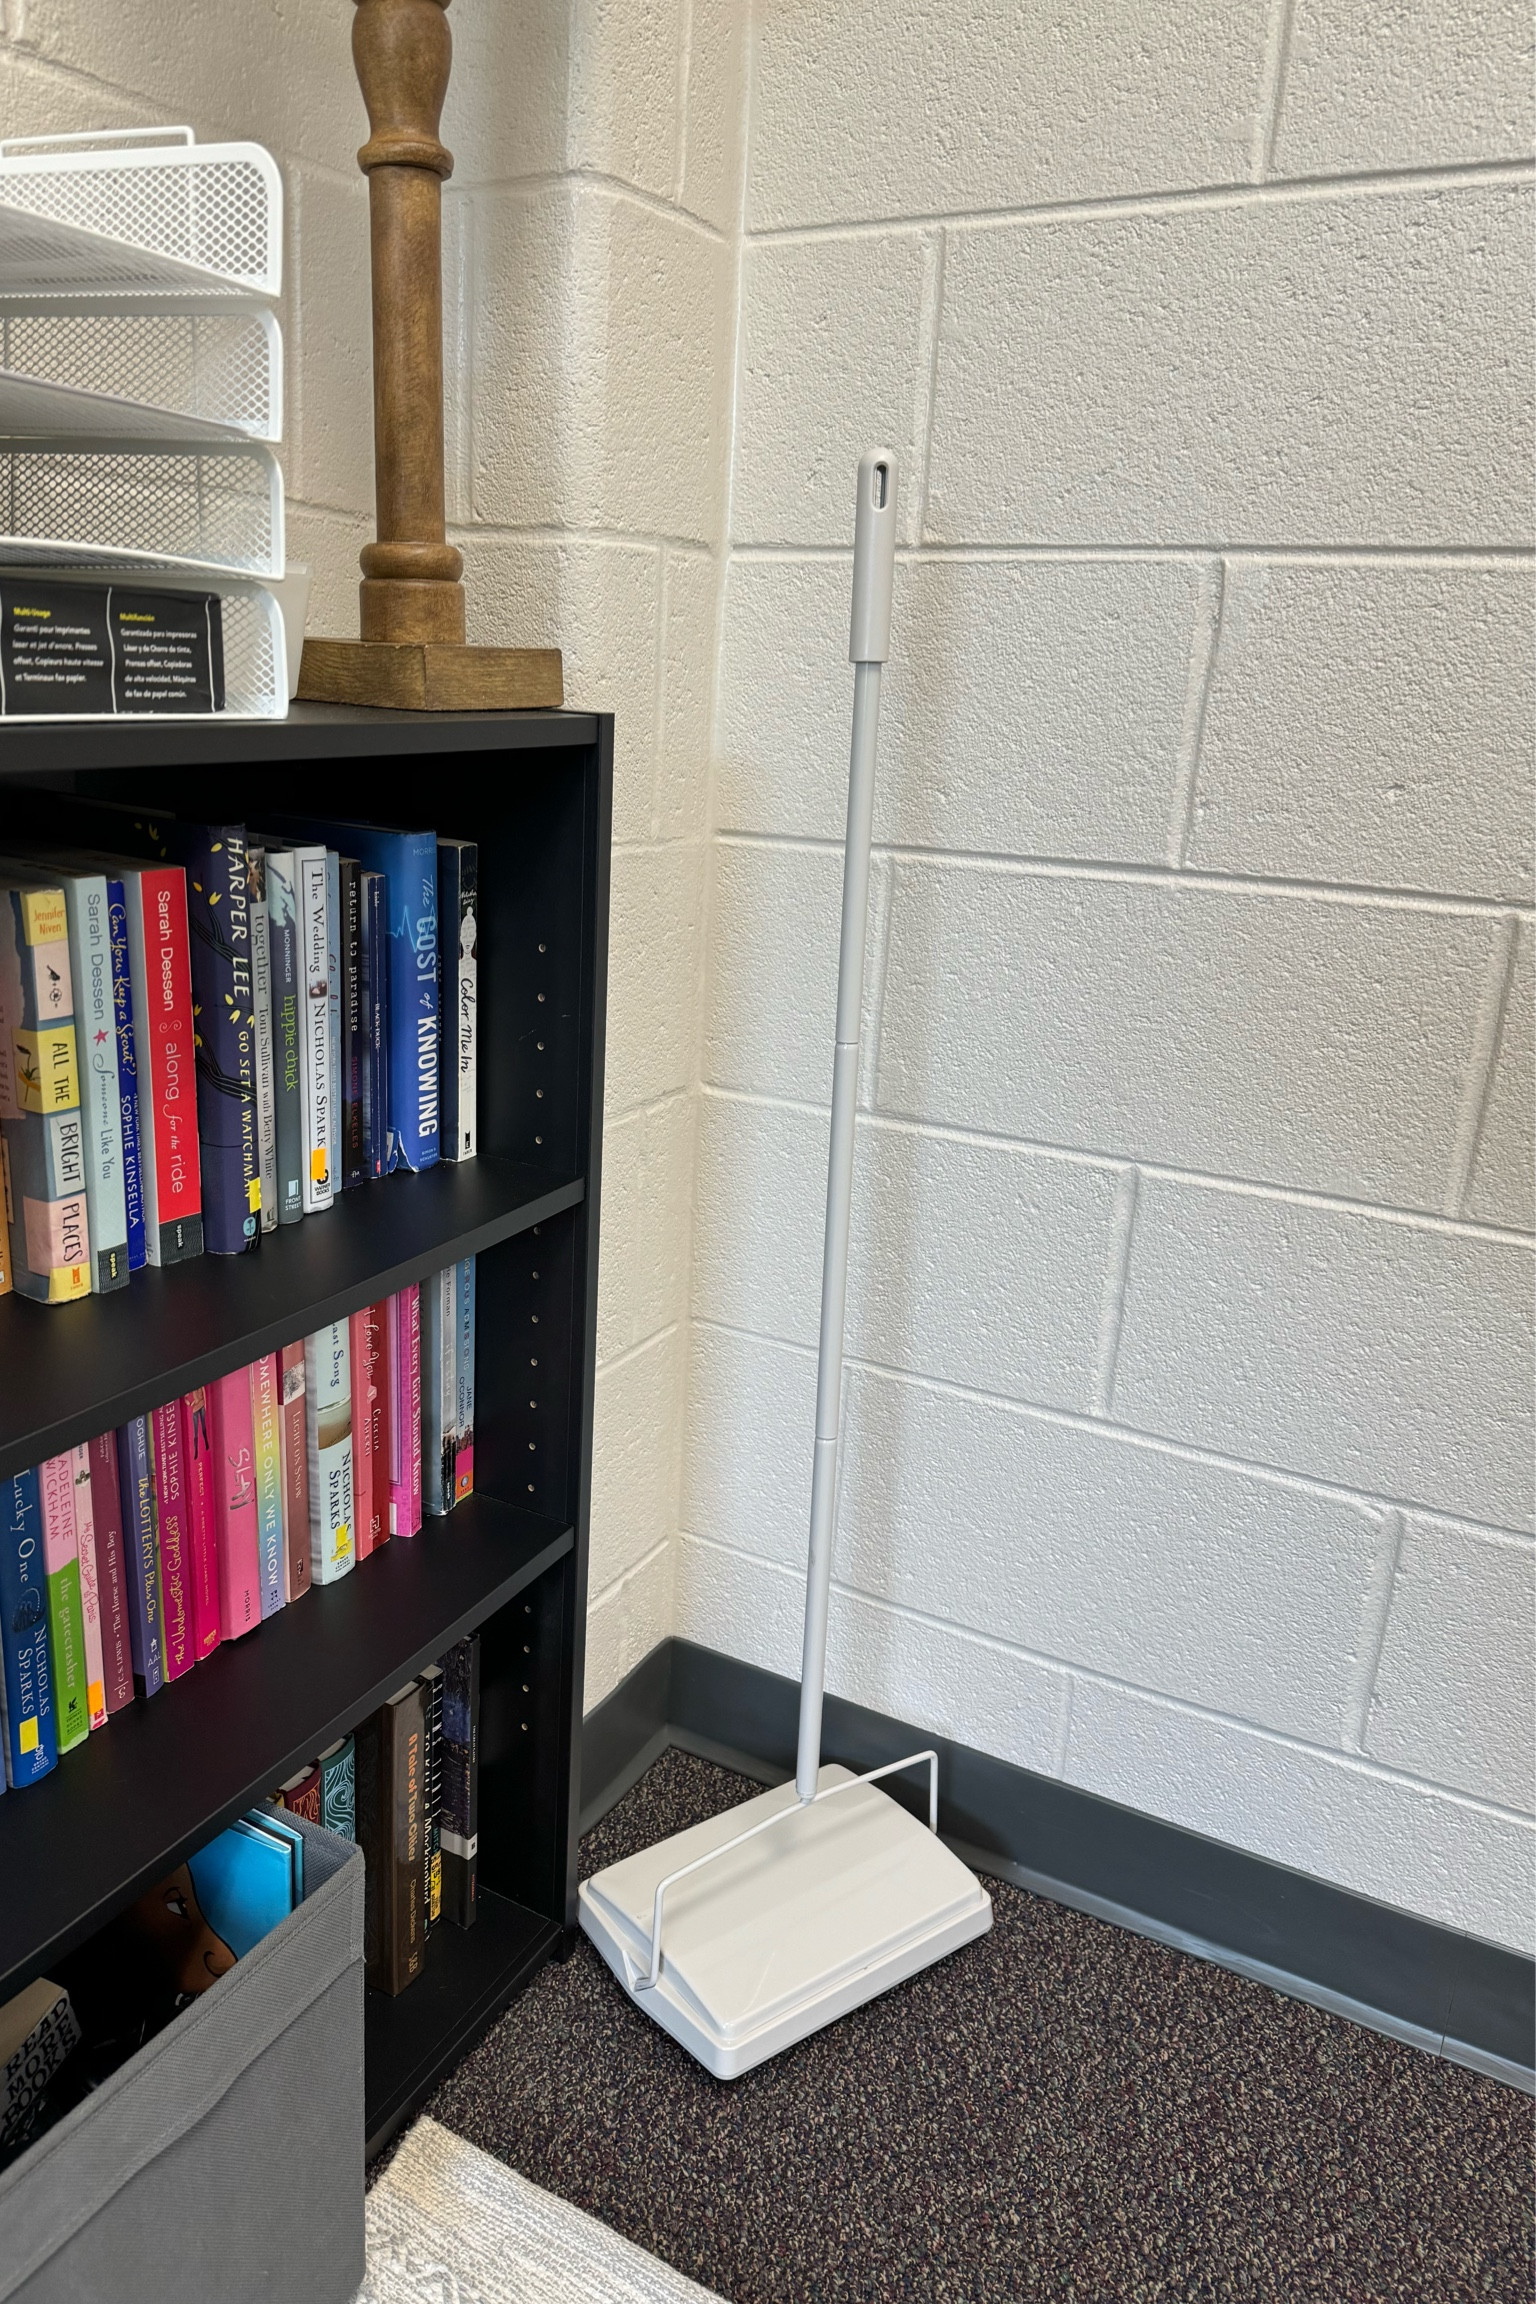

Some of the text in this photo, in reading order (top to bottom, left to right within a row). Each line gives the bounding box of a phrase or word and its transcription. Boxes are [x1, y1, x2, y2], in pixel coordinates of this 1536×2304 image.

[14, 623, 38, 633] Garanti
[39, 625, 54, 635] pour
[30, 641, 37, 649] et
[38, 641, 47, 651] jet
[120, 628, 197, 640] Garantizada para impresoras
[55, 673, 65, 681] fax
[64, 658, 81, 666] haute
[125, 674, 133, 682] de
[125, 690, 168, 700] de fax de papel
[34, 906, 65, 922] Jennifer
[39, 924, 62, 935] Niven
[227, 837, 250, 998] HARPER LEE
[87, 894, 104, 1020] Sarah Dessen
[349, 882, 357, 1031] return to paradise
[109, 903, 137, 1076] Can You Keep a Secret?
[309, 868, 327, 1090] The Wedding NICHOLAS
[280, 929, 299, 1093] MONNINGER hippie chick
[417, 874, 438, 1137] The COST of KNOWING
[158, 891, 186, 1194] Sarah Dessen along for the ride
[238, 1031, 249, 1052] GO
[460, 978, 476, 1073] Color Me In
[52, 1043, 70, 1069] ALL
[252, 915, 274, 1179] together Tom Sullivan with Betty White
[54, 1077, 70, 1104] THE
[240, 1058, 251, 1087] SET
[93, 1053, 115, 1180] Someone Like You
[241, 1093, 251, 1103] A
[59, 1122, 81, 1182] BRIGHT
[121, 1096, 140, 1229] SOPHIE KINSELLA
[285, 1196, 301, 1205] FRONT
[285, 1202, 301, 1211] STREET
[62, 1203, 83, 1263] PLACES
[109, 1253, 117, 1280] speak
[411, 1296, 420, 1334] What
[364, 1322, 379, 1350] Love
[410, 1336, 420, 1374] Every
[463, 1308, 471, 1371] ADMISSIONS
[330, 1350, 344, 1387] Song
[363, 1352, 379, 1380] You
[412, 1376, 420, 1406] Girl
[293, 1411, 301, 1447] LIGHT
[372, 1408, 381, 1451] CECELIA
[412, 1408, 421, 1458] Should
[169, 1451, 179, 1501] SOPHIE
[294, 1449, 301, 1465] ON
[228, 1447, 255, 1510] SLAY
[264, 1456, 275, 1500] ONLY
[412, 1458, 422, 1496] Know
[266, 1504, 276, 1532] WE
[330, 1470, 341, 1530] SPARKS
[10, 1469, 36, 1583] Lucky One
[107, 1530, 117, 1548] Boy
[140, 1499, 153, 1569] LOTTERYS
[80, 1521, 99, 1623] My Secret Guide Paris
[108, 1549, 117, 1566] His
[267, 1534, 278, 1586] KNOW
[111, 1587, 120, 1611] Horse
[145, 1571, 156, 1599] Plus
[166, 1515, 186, 1646] Undomestic Goddess
[113, 1613, 121, 1633] The
[147, 1600, 157, 1624] One
[58, 1577, 78, 1687] the gatecrasher
[34, 1624, 50, 1716] NICHOLAS
[115, 1640, 123, 1666] LEWIS
[18, 1647, 35, 1715] SPARKS
[408, 1733, 418, 1861] A Tale of Two Cities
[409, 1910, 417, 1943] Dickens
[4, 1997, 68, 2081] READ
[7, 2013, 69, 2101] MORE
[2, 2033, 77, 2127] BOOKS
